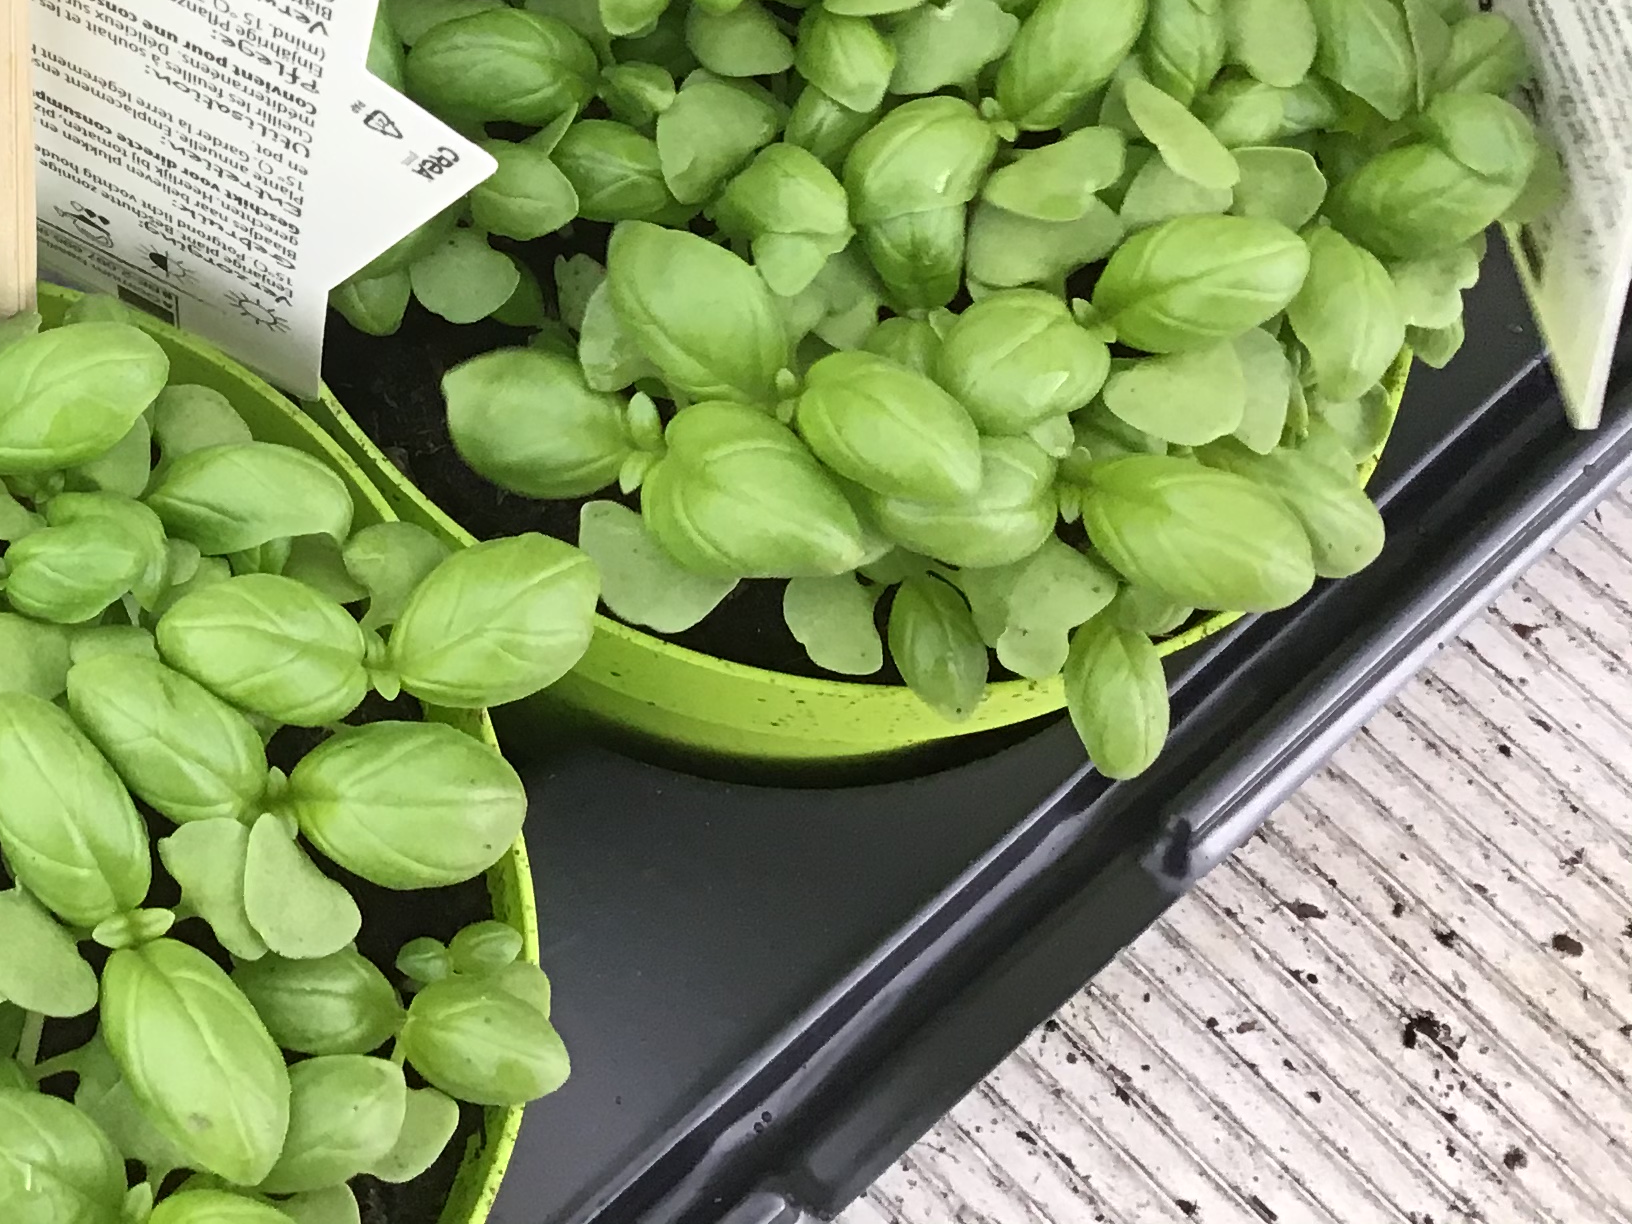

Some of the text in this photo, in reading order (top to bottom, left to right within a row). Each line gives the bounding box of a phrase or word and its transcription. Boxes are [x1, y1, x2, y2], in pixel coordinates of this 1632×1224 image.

[65, 9, 80, 23] et
[95, 9, 168, 55] Délicieux
[142, 19, 177, 43] une
[243, 12, 261, 30] 15
[85, 19, 145, 56] souhait
[182, 40, 227, 68] pour
[235, 25, 322, 77] Einjährige
[41, 47, 131, 102] légèrement
[151, 53, 160, 66] à
[210, 23, 319, 93] Pflege:
[165, 60, 223, 98] feuilles
[232, 64, 316, 114] Convient
[33, 102, 55, 118] piz
[64, 73, 171, 136] Emplacement
[136, 97, 173, 122] terre
[145, 64, 309, 158] Utilisation:
[228, 93, 250, 113] les
[40, 118, 58, 132] en
[58, 114, 127, 157] tomaten,
[178, 118, 191, 133] la
[255, 107, 312, 143] Cueillir
[34, 143, 78, 174] houde
[62, 130, 121, 165] plukken
[116, 132, 177, 169] directe
[131, 151, 150, 170] bij
[196, 129, 249, 162] Garder
[39, 156, 97, 192] zonnige
[83, 167, 136, 202] vochtig
[126, 163, 189, 204] believen
[154, 165, 212, 203] Heerlijk
[160, 136, 301, 217] Entretien:
[181, 167, 220, 192] voor
[288, 160, 307, 175] en
[253, 171, 303, 205] Plante
[101, 190, 173, 235] Beschutte
[141, 199, 172, 223] licht
[193, 200, 227, 222] naar
[224, 189, 299, 234] Geschikt
[172, 199, 295, 269] Gebruik:
[177, 219, 245, 261] Potgrond
[232, 219, 296, 260] Blaadjes
